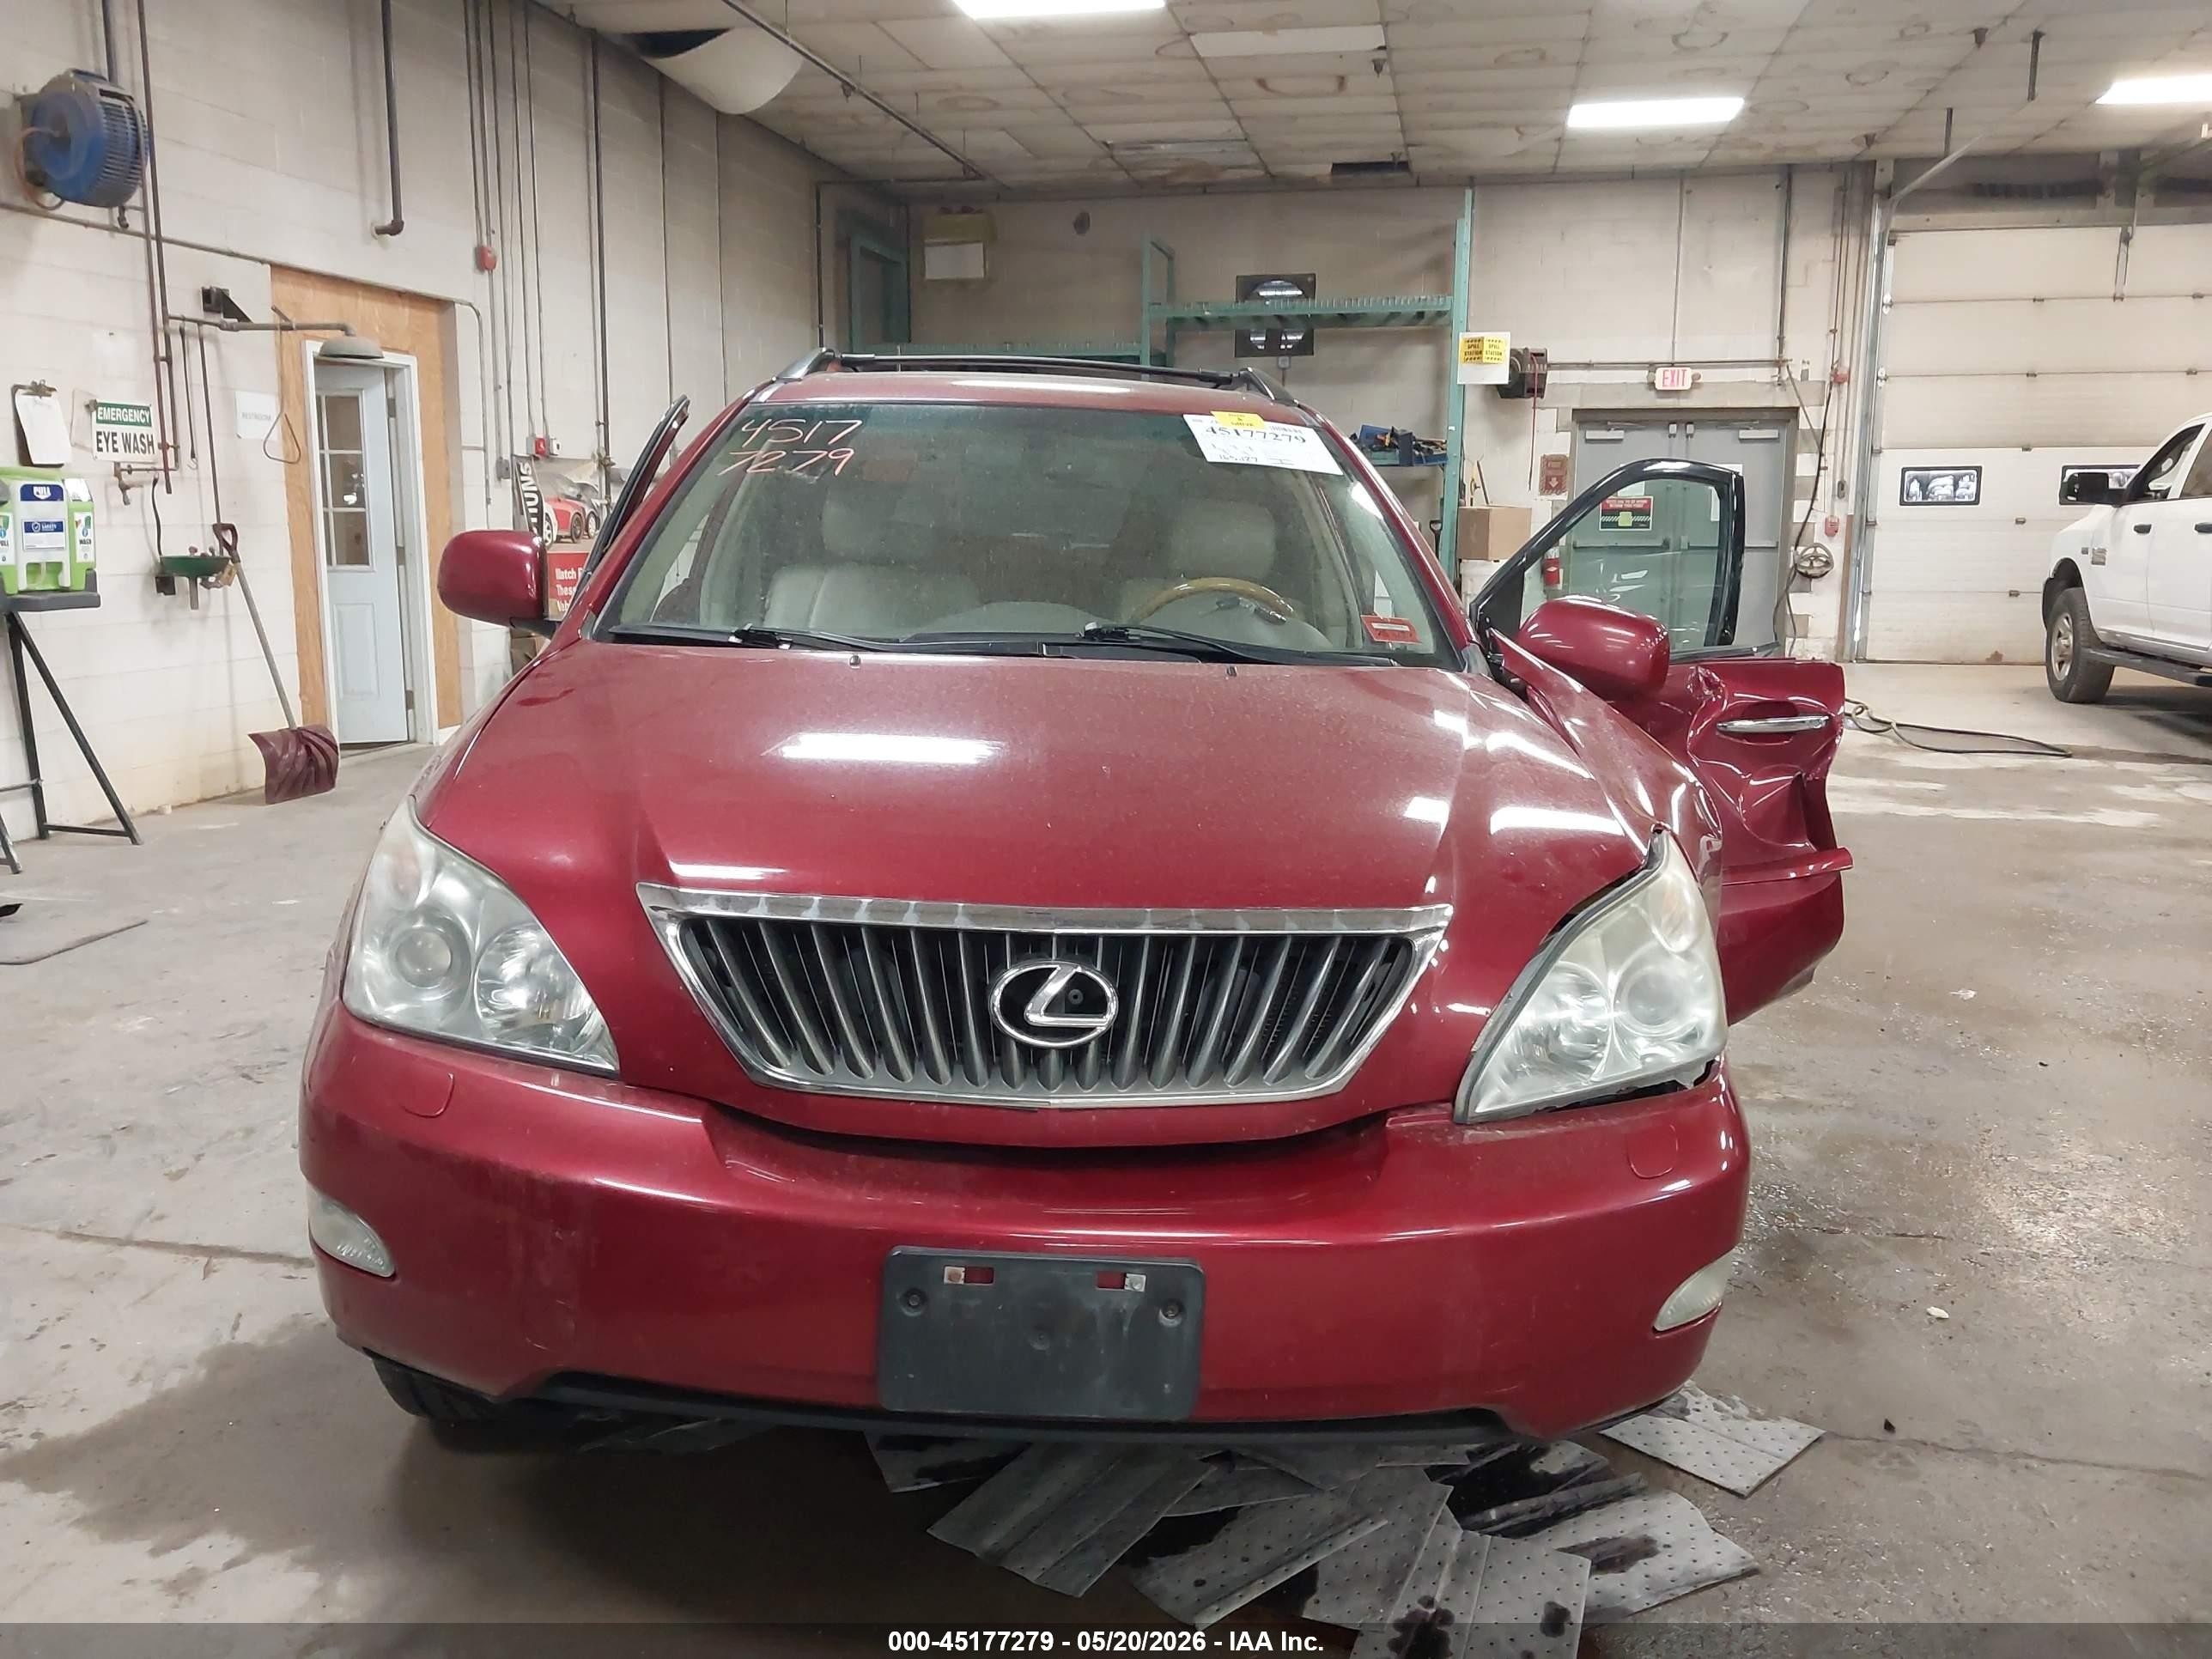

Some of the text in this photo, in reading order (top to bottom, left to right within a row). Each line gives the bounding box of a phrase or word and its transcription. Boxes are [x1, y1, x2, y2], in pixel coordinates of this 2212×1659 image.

[1662, 368, 1687, 387] EXIT
[96, 406, 150, 423] EMERGENCY
[95, 430, 155, 455] EYE WASH
[740, 418, 862, 448] 4517
[716, 447, 854, 477] 7279
